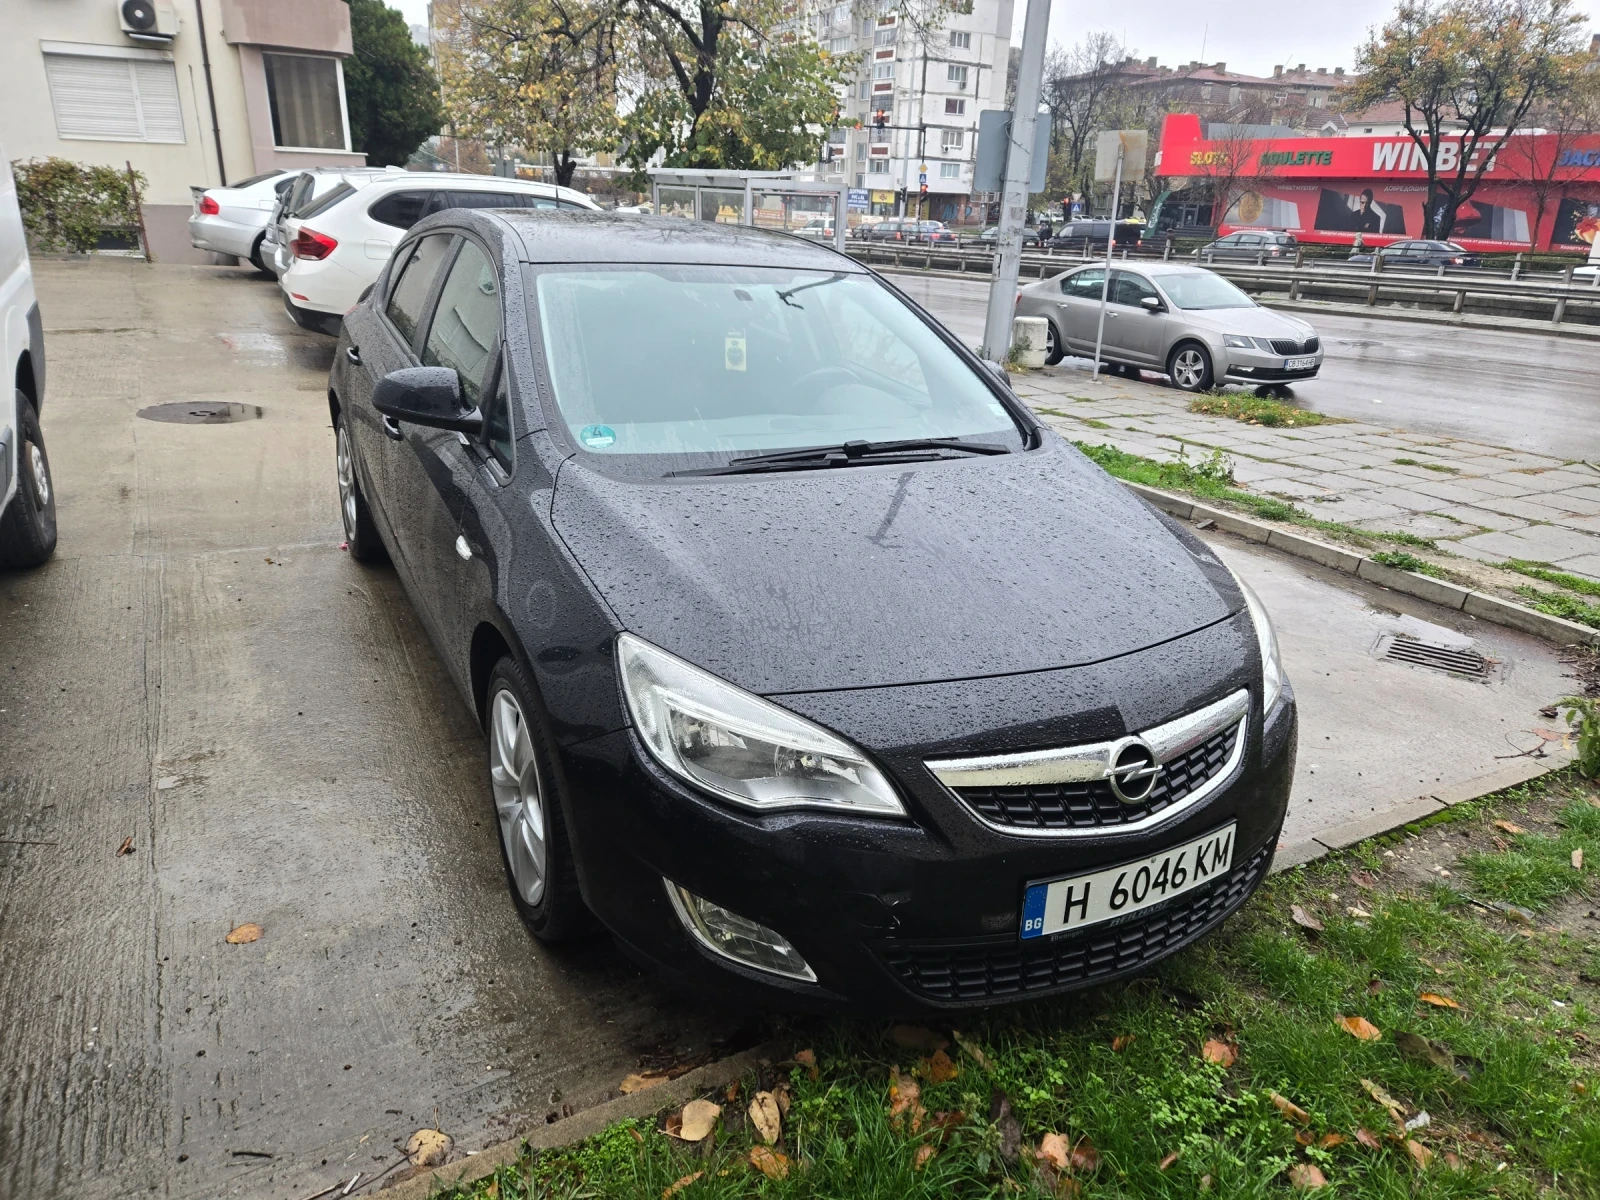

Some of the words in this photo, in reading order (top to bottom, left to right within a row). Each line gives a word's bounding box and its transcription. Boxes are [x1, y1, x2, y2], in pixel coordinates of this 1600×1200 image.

[1261, 151, 1333, 166] ROULETTE
[1373, 142, 1508, 172] WINBET
[1063, 881, 1091, 924] H
[1109, 851, 1187, 911] 6046
[1193, 831, 1232, 882] KM
[1024, 917, 1042, 931] BG
[1050, 929, 1084, 942] Ellwangen
